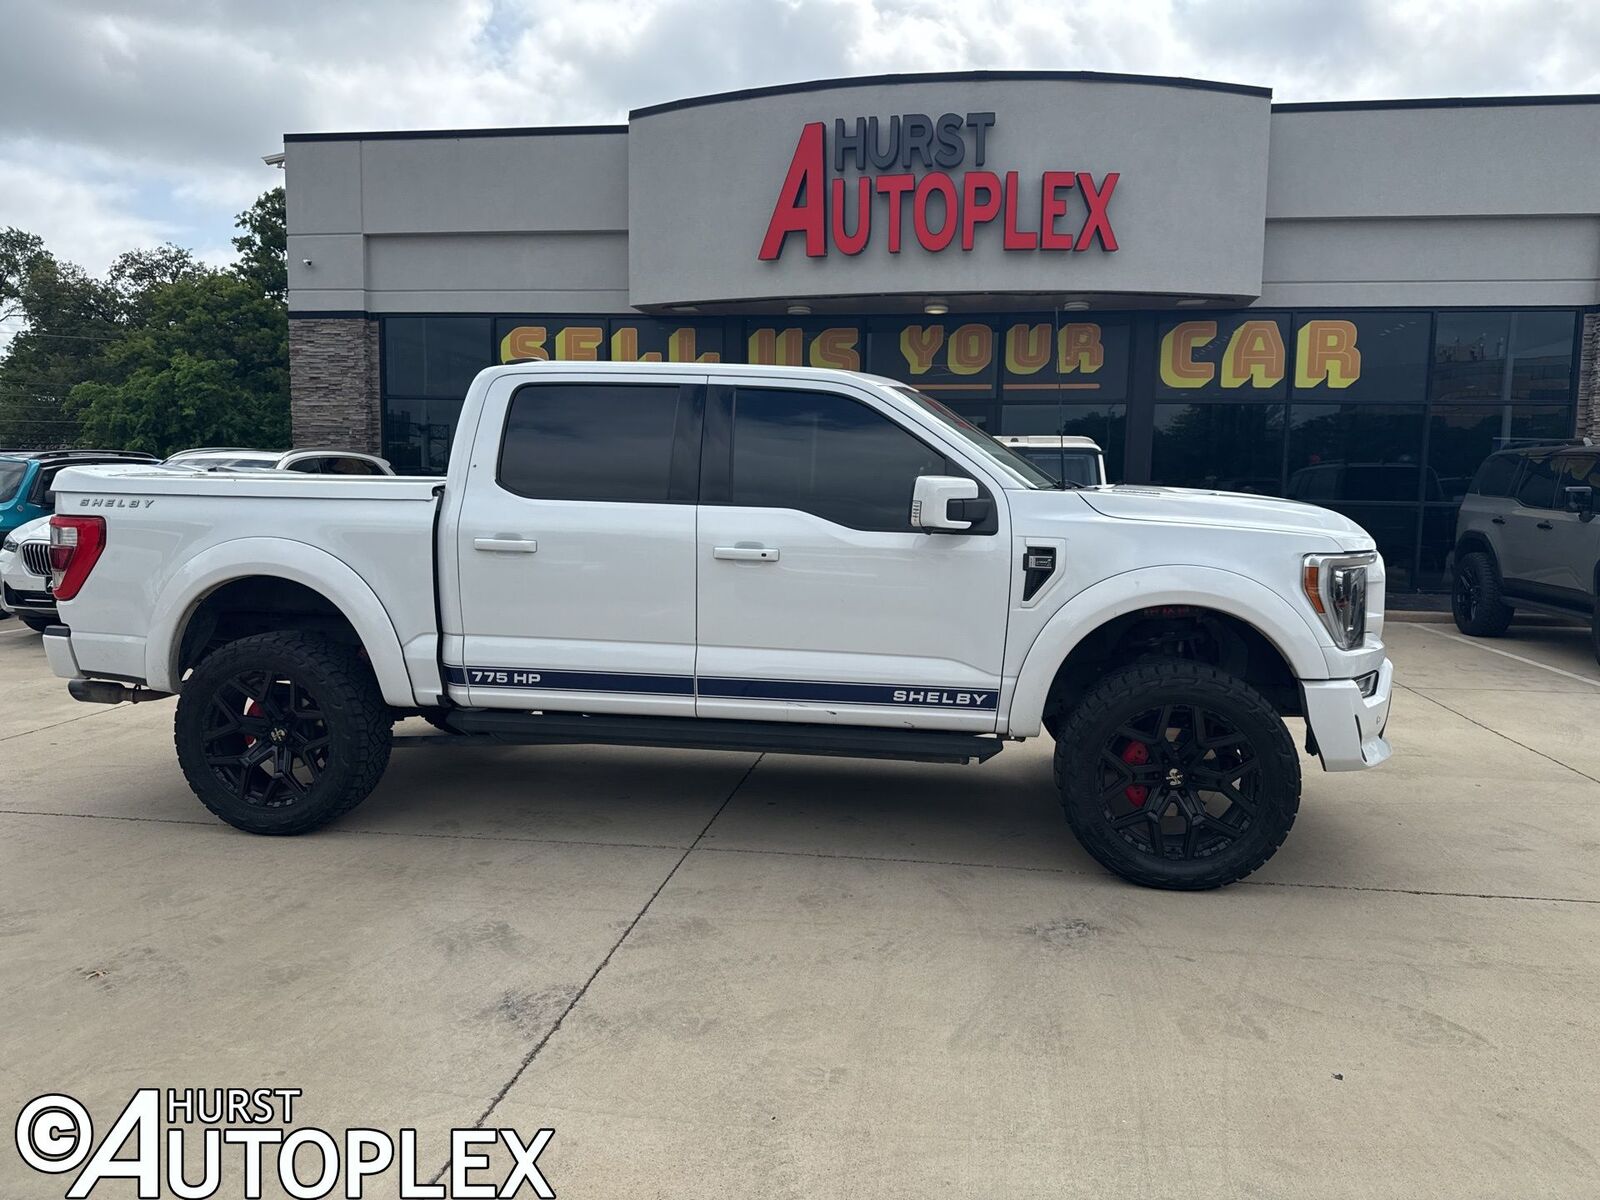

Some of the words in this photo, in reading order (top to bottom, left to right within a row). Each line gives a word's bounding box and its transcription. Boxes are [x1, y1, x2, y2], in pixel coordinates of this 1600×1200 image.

[834, 112, 996, 171] HURST
[758, 121, 1121, 261] AUTOPLEX
[900, 323, 1104, 375] YOUR
[1160, 320, 1361, 388] CAR
[80, 498, 154, 509] SHELBY
[471, 671, 508, 683] 775
[513, 672, 541, 684] HP
[893, 690, 988, 705] SHELBY
